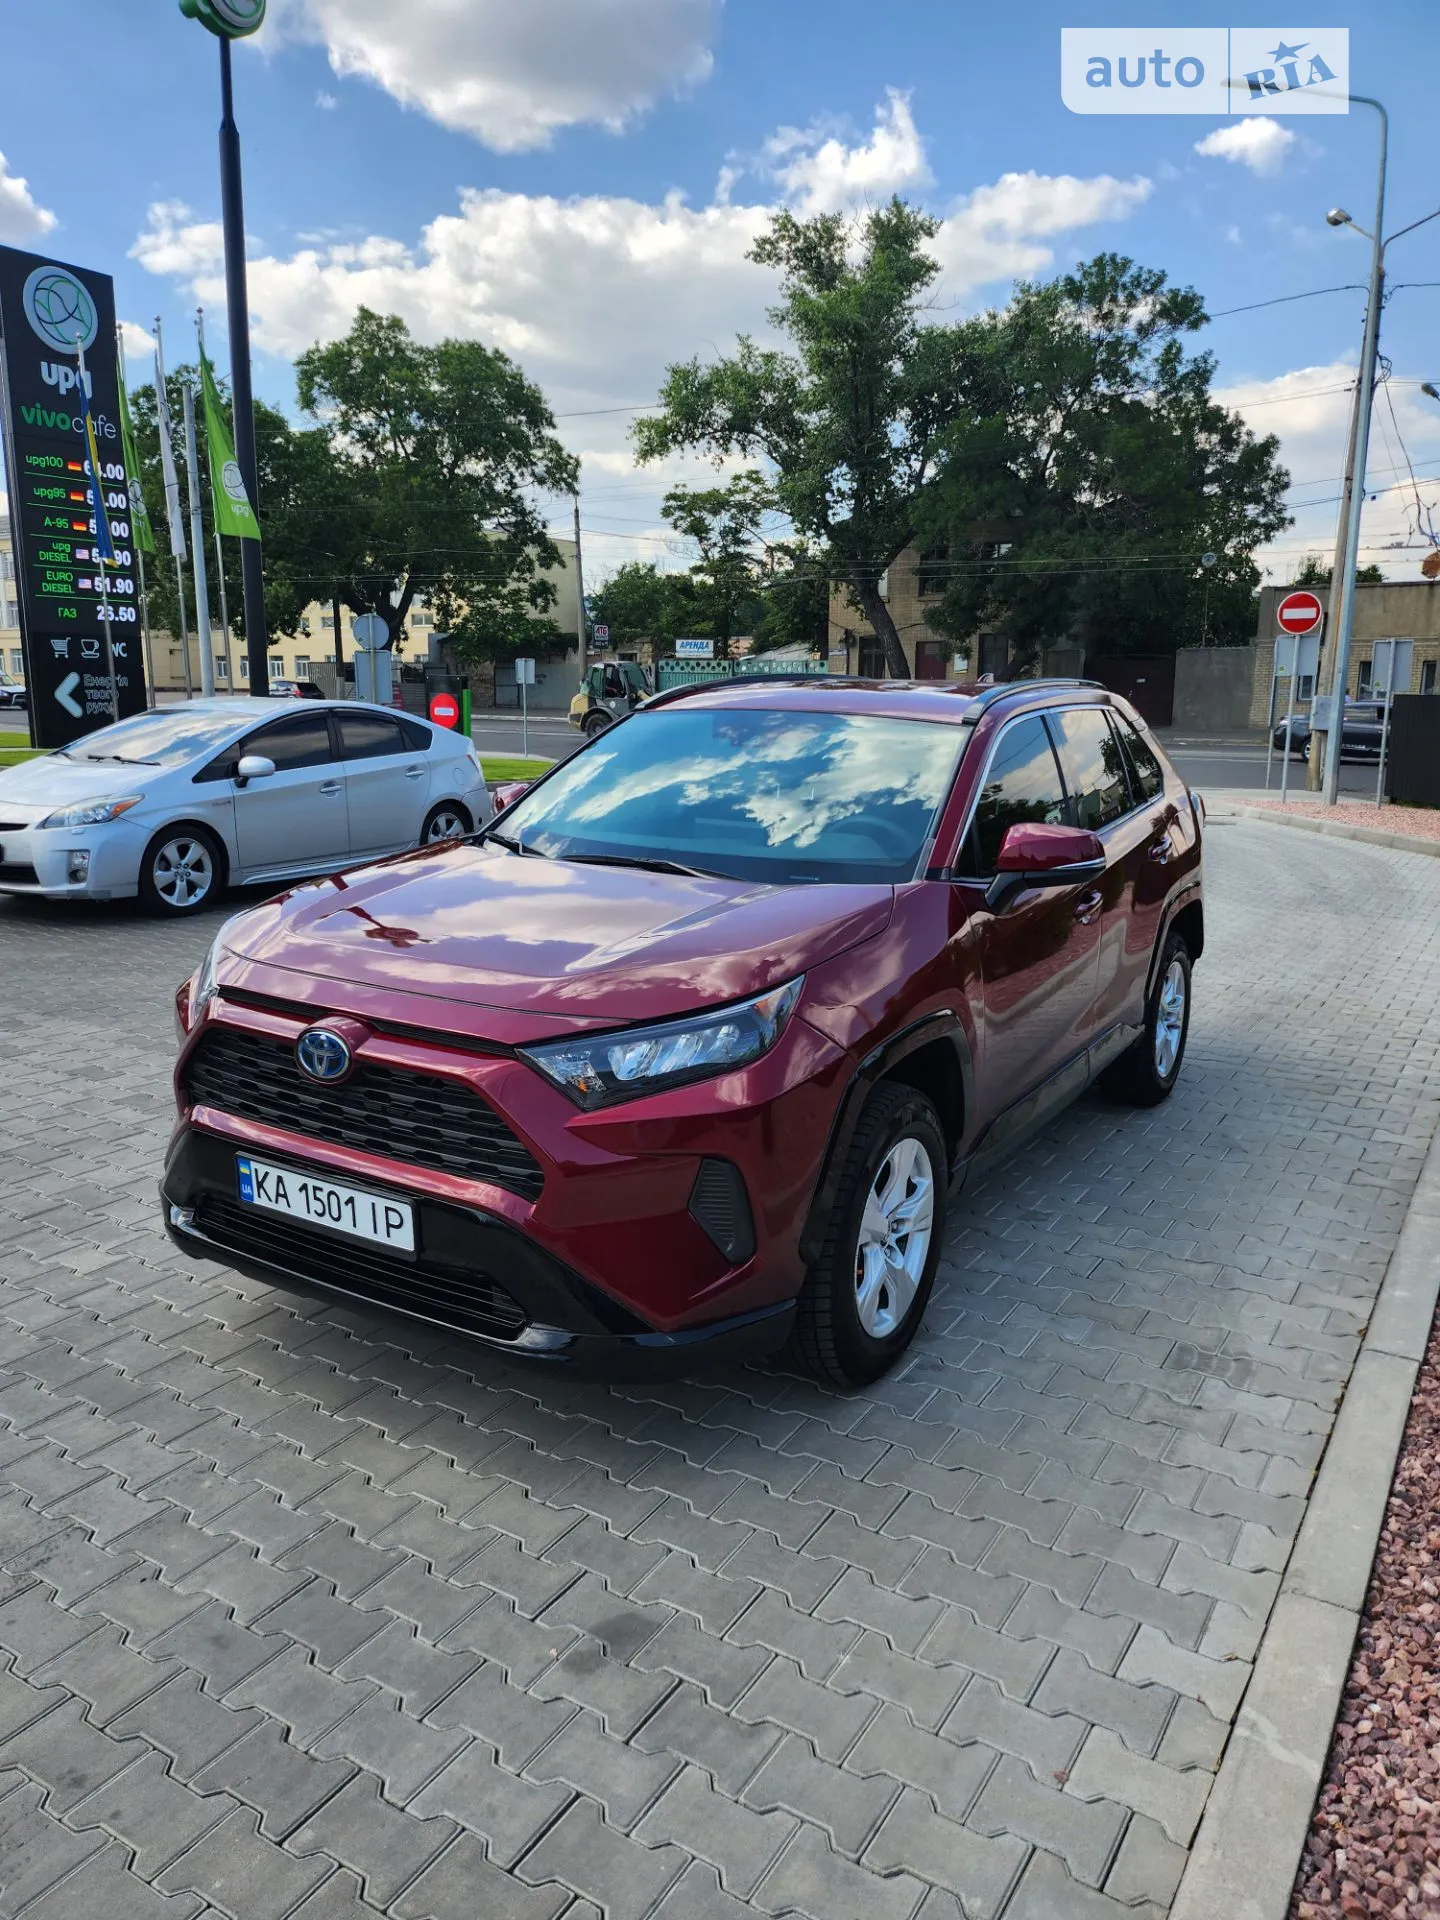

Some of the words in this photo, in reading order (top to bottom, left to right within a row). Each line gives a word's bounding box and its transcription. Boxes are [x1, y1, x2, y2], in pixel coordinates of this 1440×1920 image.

[25, 455, 63, 468] upg100
[33, 487, 66, 499] upg95
[230, 503, 249, 518] upg
[52, 542, 71, 553] upg
[39, 551, 72, 563] DIESEL
[46, 571, 74, 581] EURO
[42, 582, 76, 593] DIESEL
[94, 576, 134, 594] 51.90
[58, 607, 77, 618] ГАЗ
[680, 641, 710, 650] АРЕНДА
[242, 1183, 253, 1194] UA
[254, 1168, 291, 1208] KA
[298, 1182, 357, 1229] 1501
[371, 1202, 404, 1238] IP
